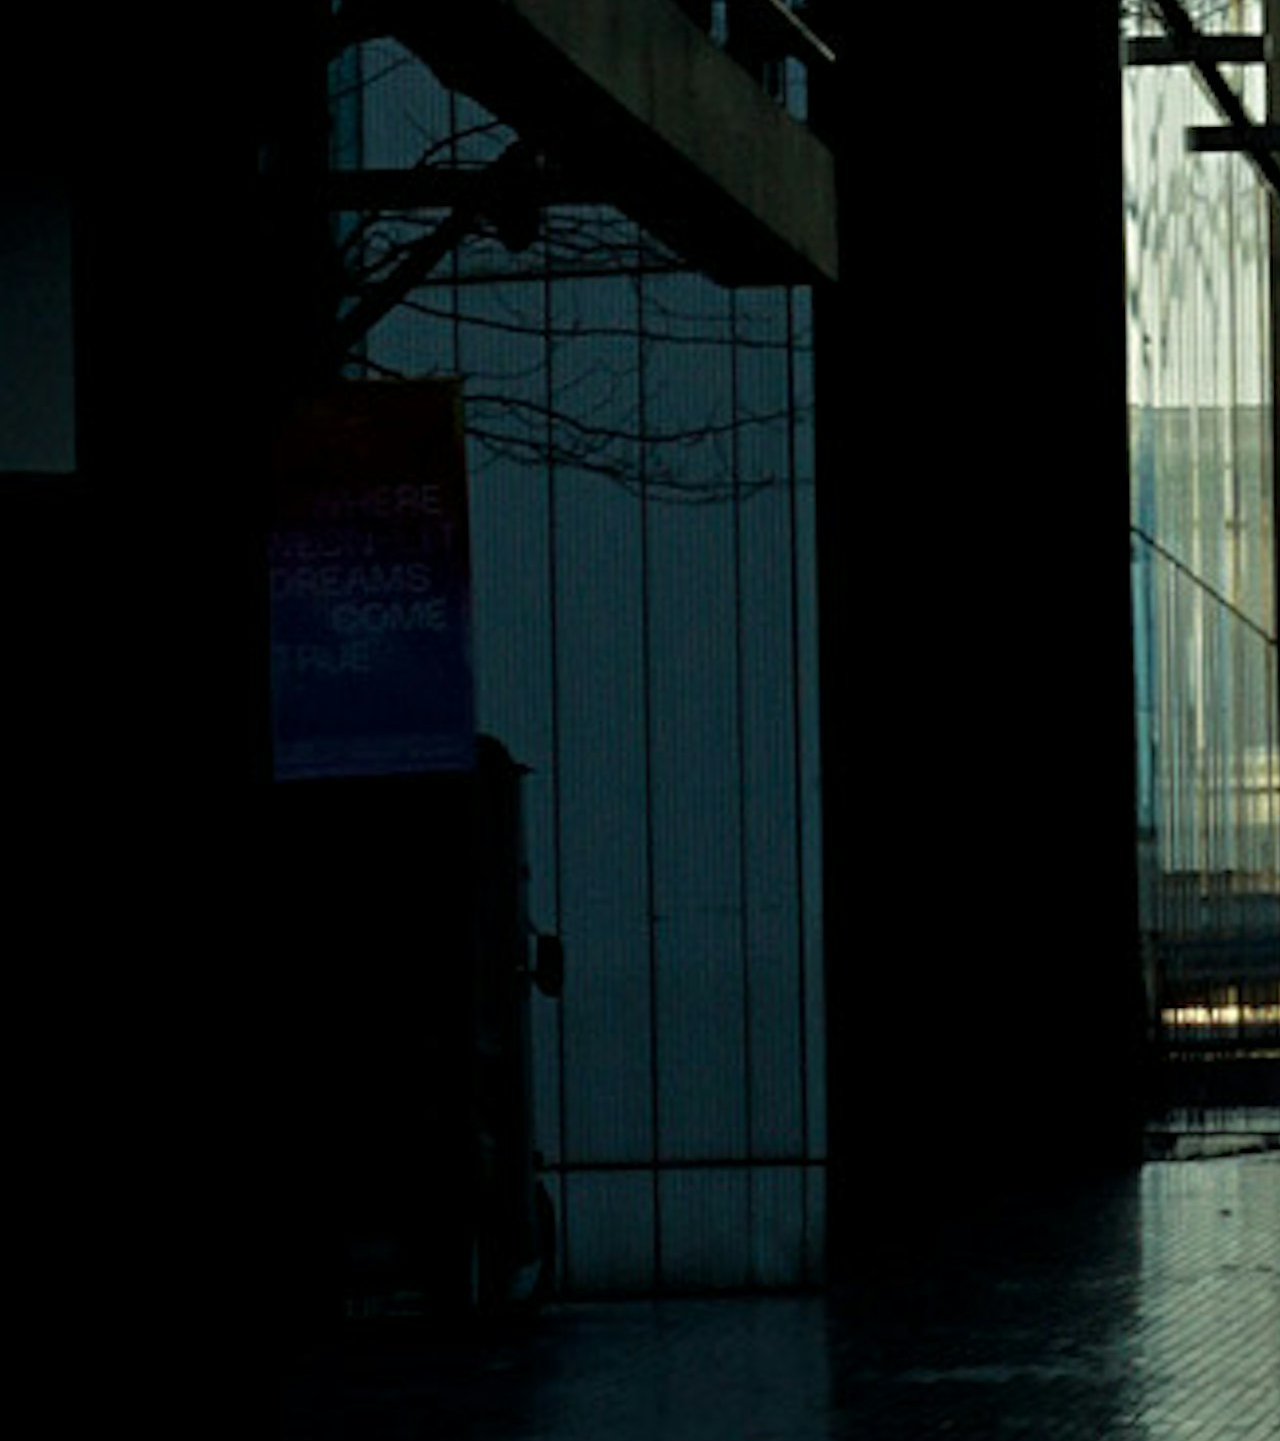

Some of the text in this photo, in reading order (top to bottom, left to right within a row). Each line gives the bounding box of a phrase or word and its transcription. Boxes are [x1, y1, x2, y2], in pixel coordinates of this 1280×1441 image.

[271, 562, 432, 600] DREAMS
[332, 597, 448, 634] COME
[271, 641, 372, 675] TRUE
